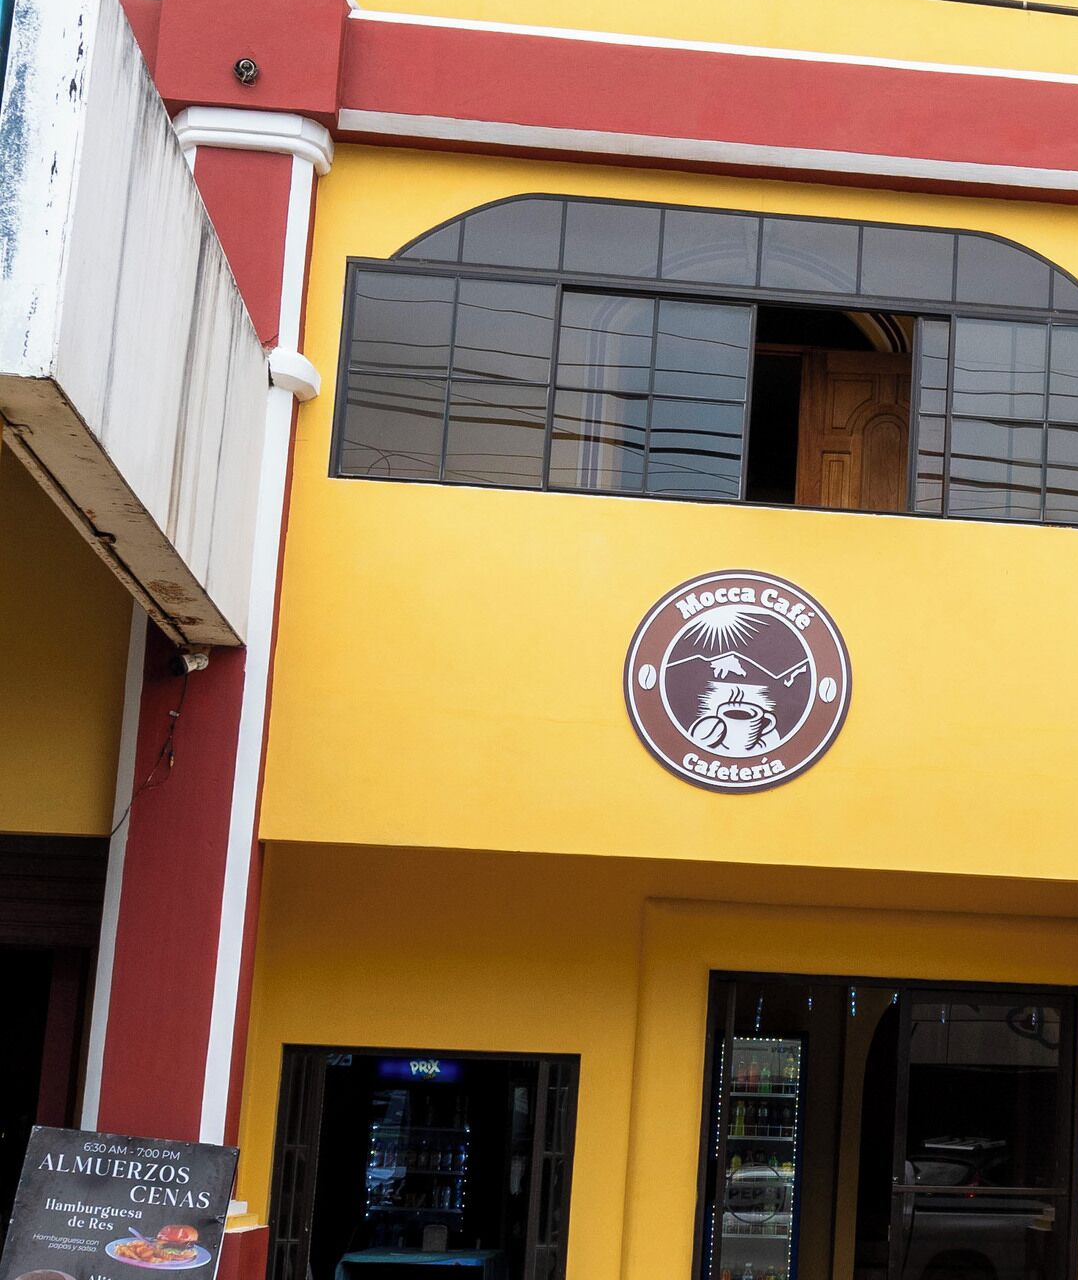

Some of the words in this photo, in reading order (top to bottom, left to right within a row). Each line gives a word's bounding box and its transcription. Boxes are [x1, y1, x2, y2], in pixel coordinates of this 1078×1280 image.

[675, 587, 756, 620] Mocca
[761, 588, 816, 631] Café
[682, 753, 786, 782] Cafetería
[84, 1142, 106, 1154] 6:30
[108, 1145, 127, 1156] AM
[136, 1147, 160, 1159] 7:00
[162, 1150, 181, 1160] PM
[38, 1153, 190, 1184] ALMUERZOS
[129, 1185, 211, 1209] CENAS
[45, 1198, 143, 1219] Hamburguesa
[67, 1215, 85, 1228] de
[88, 1218, 114, 1231] Res
[32, 1233, 85, 1244] Hamburguesa
[48, 1241, 71, 1249] papas
